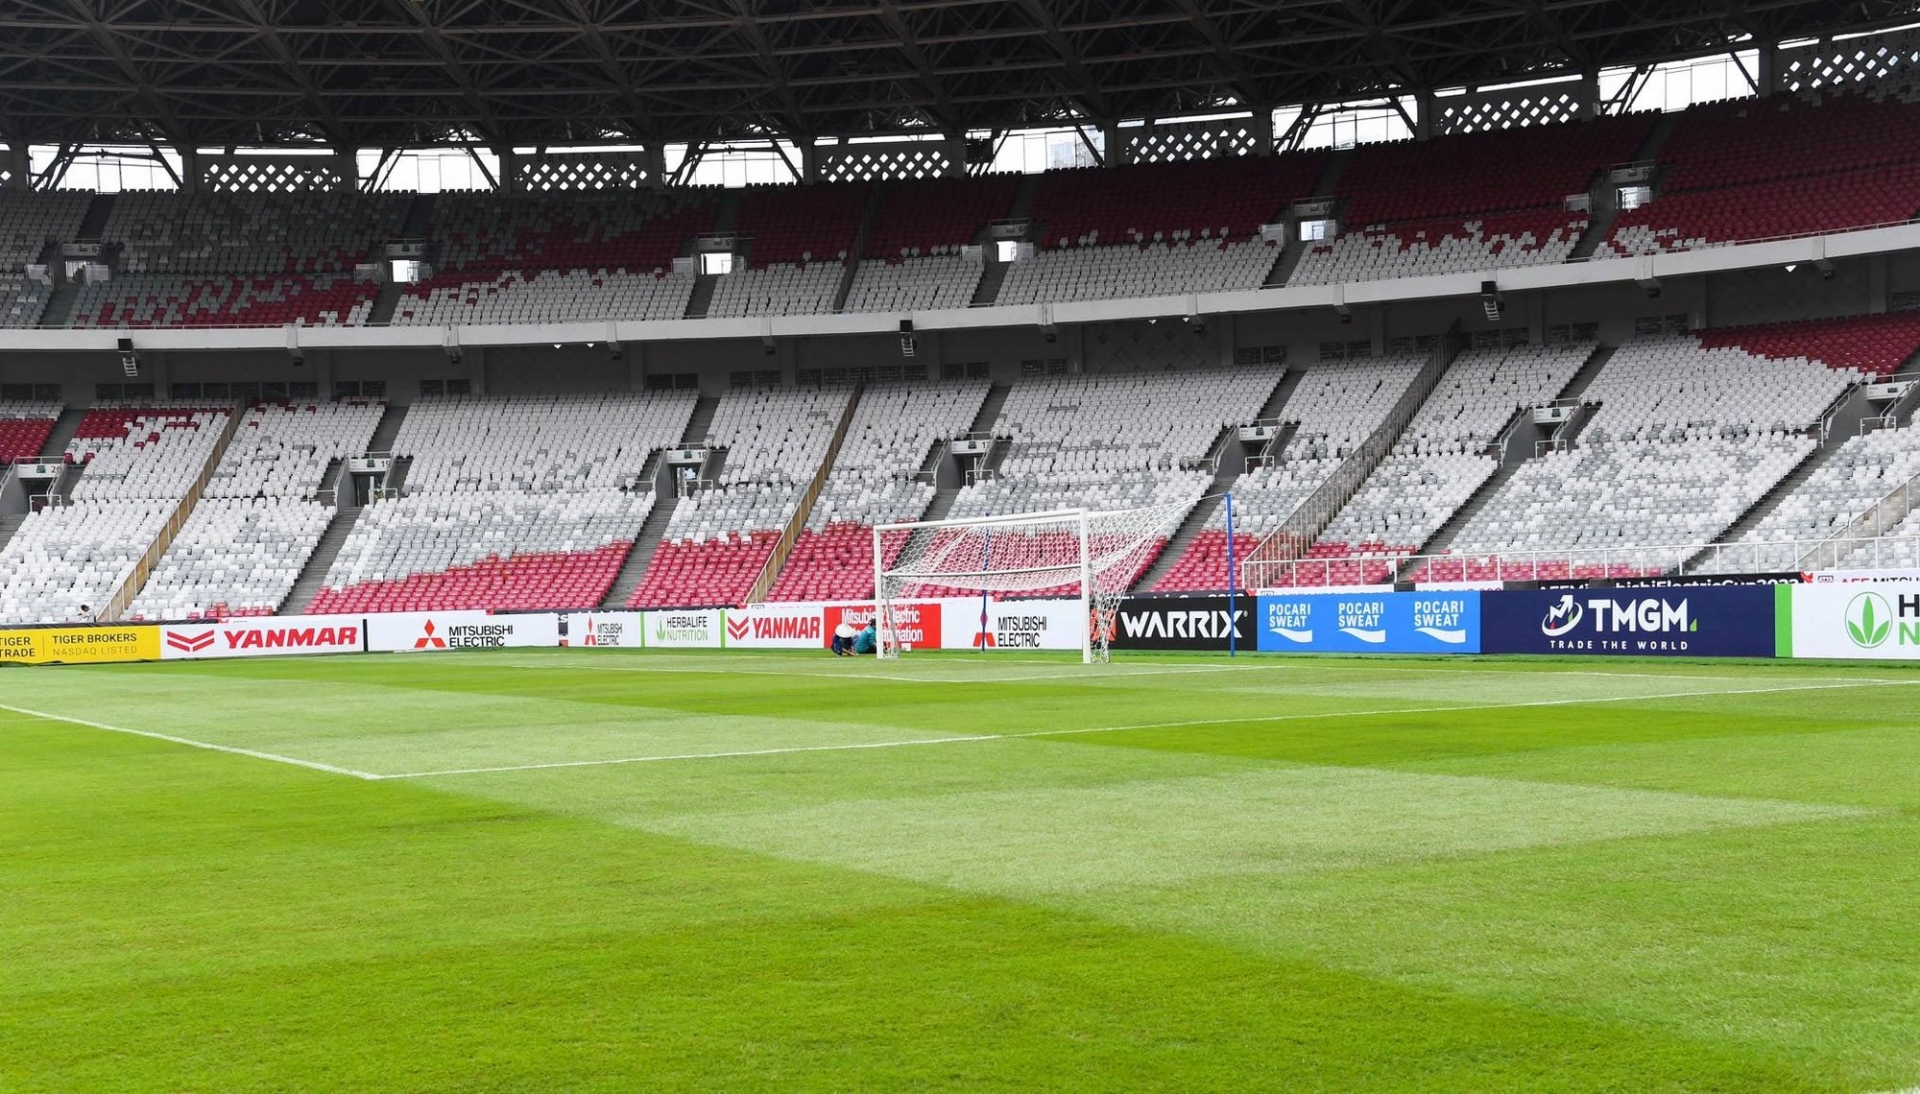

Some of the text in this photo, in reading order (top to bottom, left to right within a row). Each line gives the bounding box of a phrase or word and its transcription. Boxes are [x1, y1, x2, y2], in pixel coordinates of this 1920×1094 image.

[1268, 603, 1311, 616] POCARI
[1338, 602, 1384, 615] POCARI
[1414, 600, 1464, 614] POCARI
[666, 616, 708, 628] HERBALIFE
[1268, 615, 1307, 627] SWEAT
[1338, 614, 1380, 627] SWEAT
[1414, 613, 1459, 627] SWEAT
[1588, 598, 1688, 633] TMGM
[753, 616, 821, 639] YANMAR
[998, 616, 1047, 631] MITSUBISHI
[1120, 610, 1243, 639] WARRIX
[448, 625, 514, 637] MITSUBISHI
[667, 629, 709, 642] NUTRITION
[52, 633, 137, 644] TIGER BROKERS
[224, 627, 357, 649] YANMAR
[449, 636, 506, 648] ELECTRIC
[998, 632, 1041, 648] ELECTRIC
[53, 645, 138, 656] NASDAQ LISTED
[1550, 640, 1688, 651] TRADE THE WORLD
